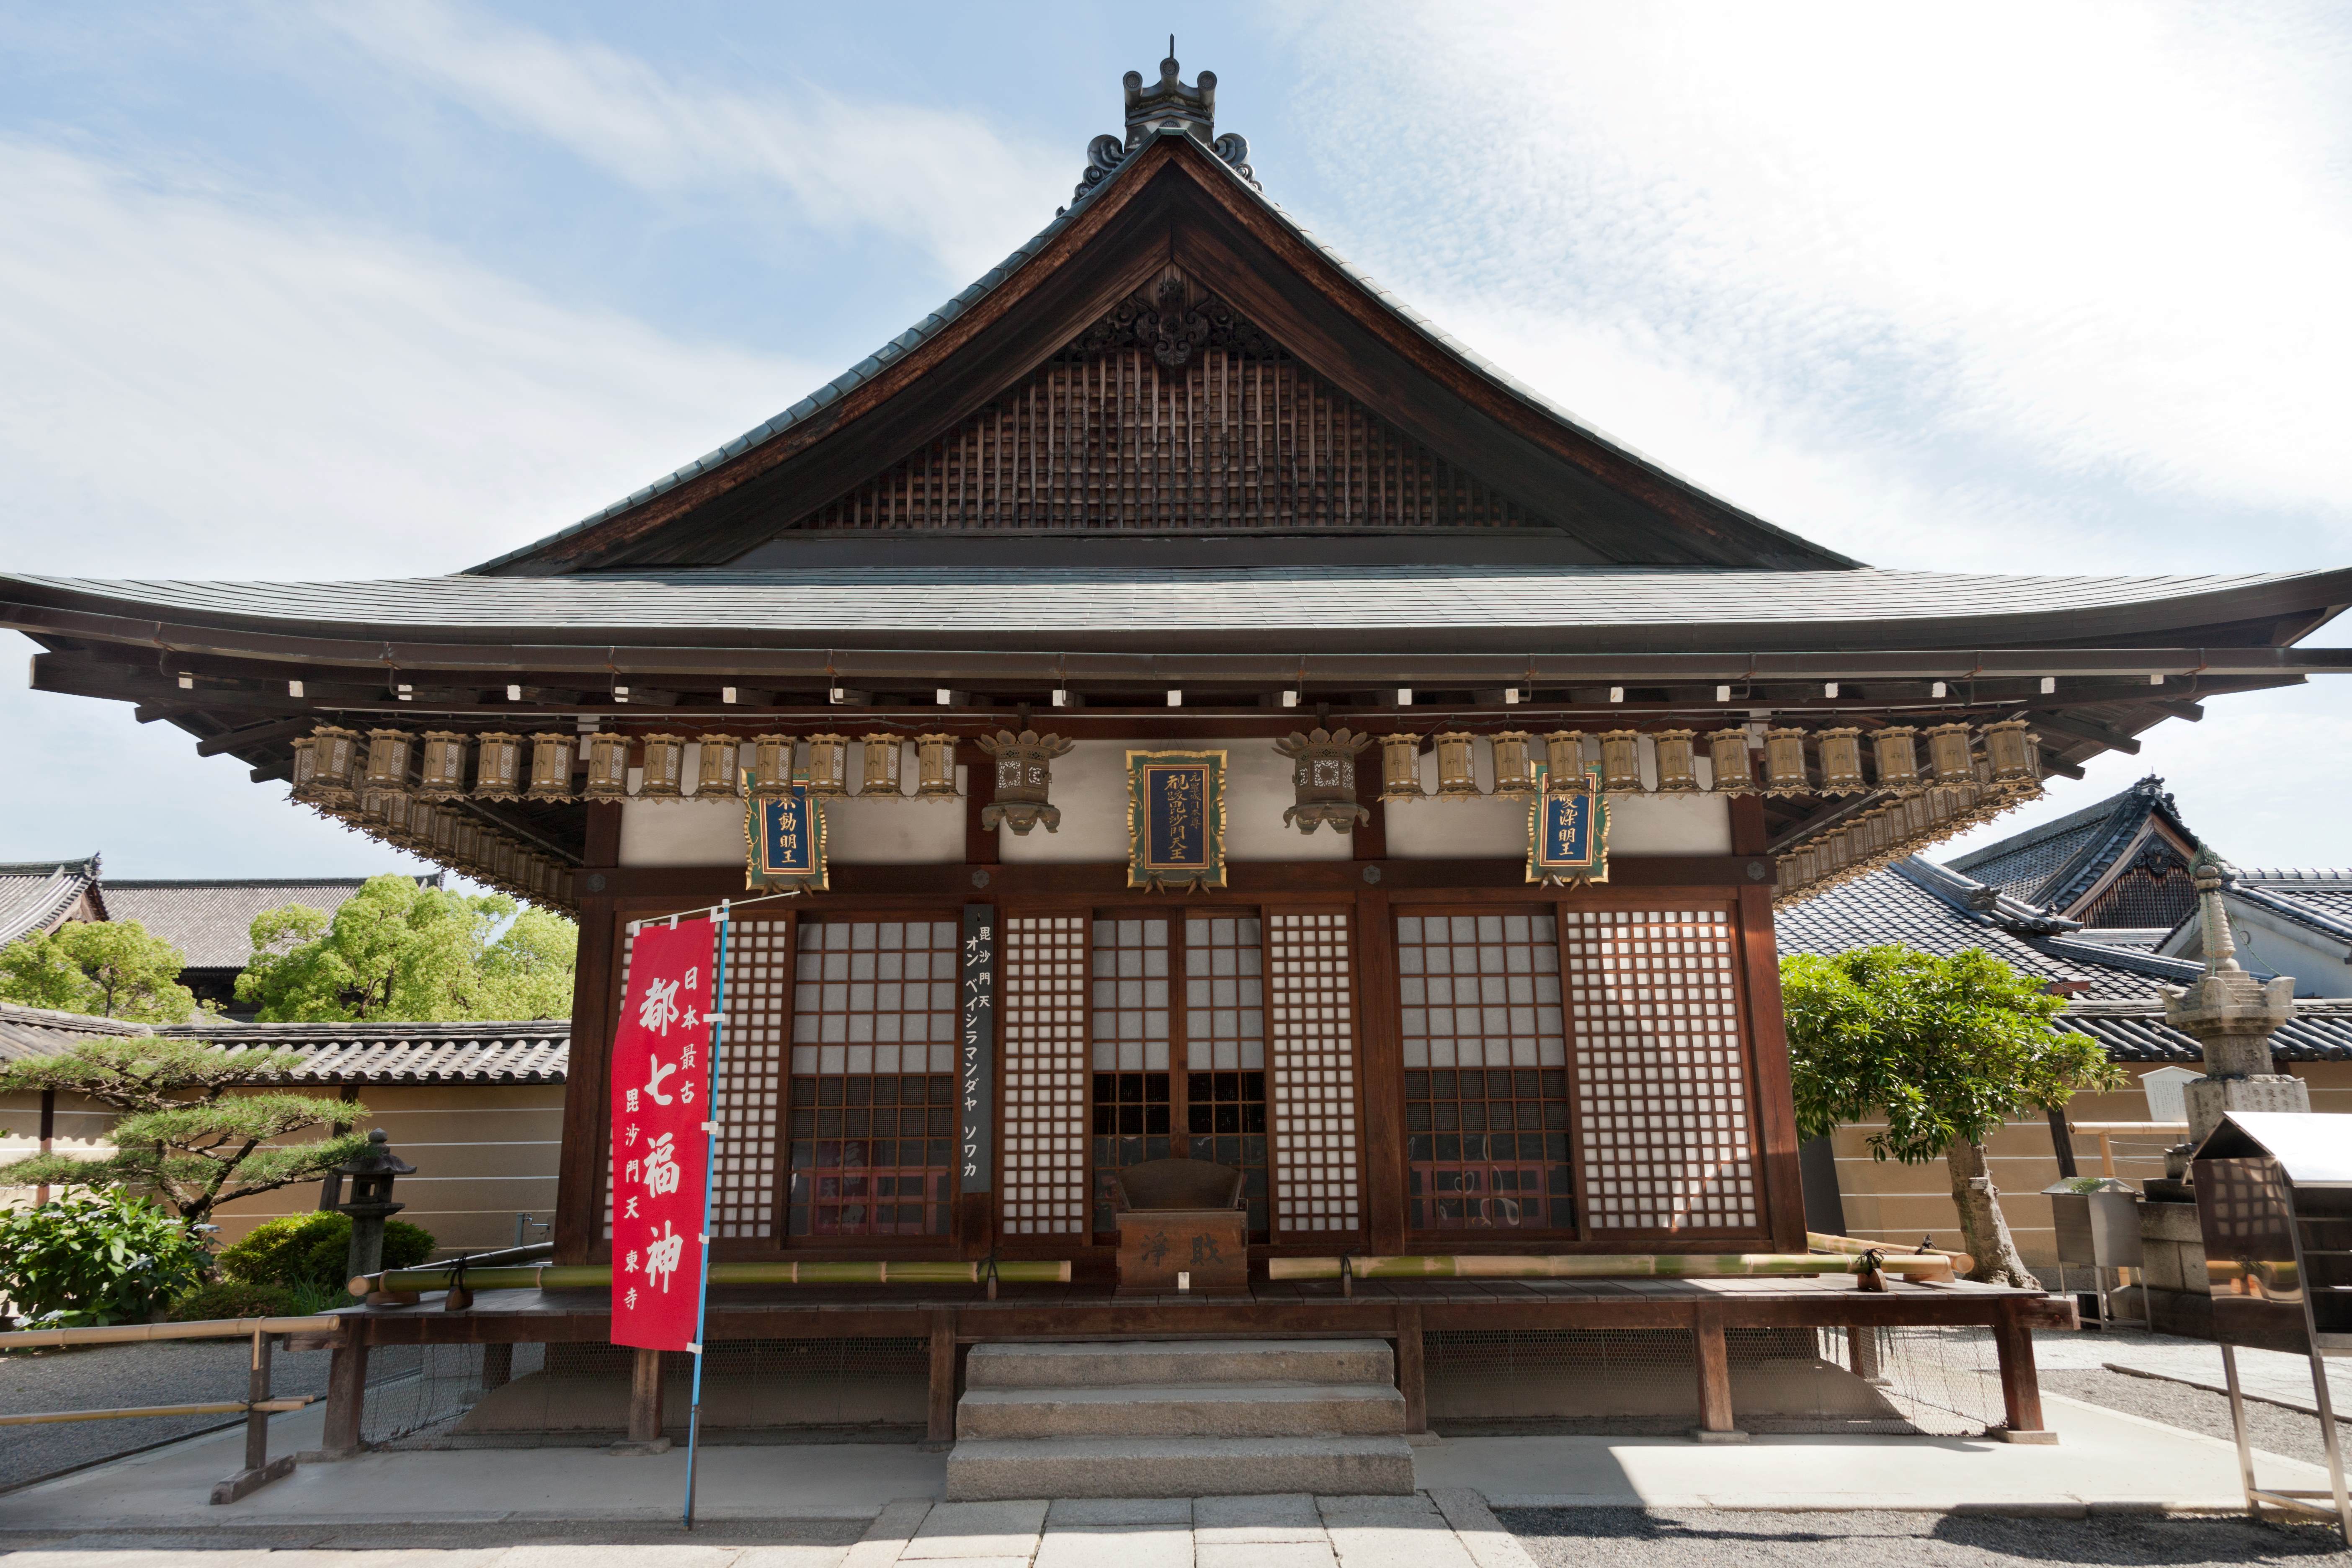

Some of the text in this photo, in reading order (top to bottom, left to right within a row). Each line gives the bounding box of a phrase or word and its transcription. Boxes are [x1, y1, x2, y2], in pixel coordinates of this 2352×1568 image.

[681, 966, 699, 1104] 日本最古
[979, 926, 991, 1008] 毘沙門天
[640, 977, 683, 1293] 都七福神
